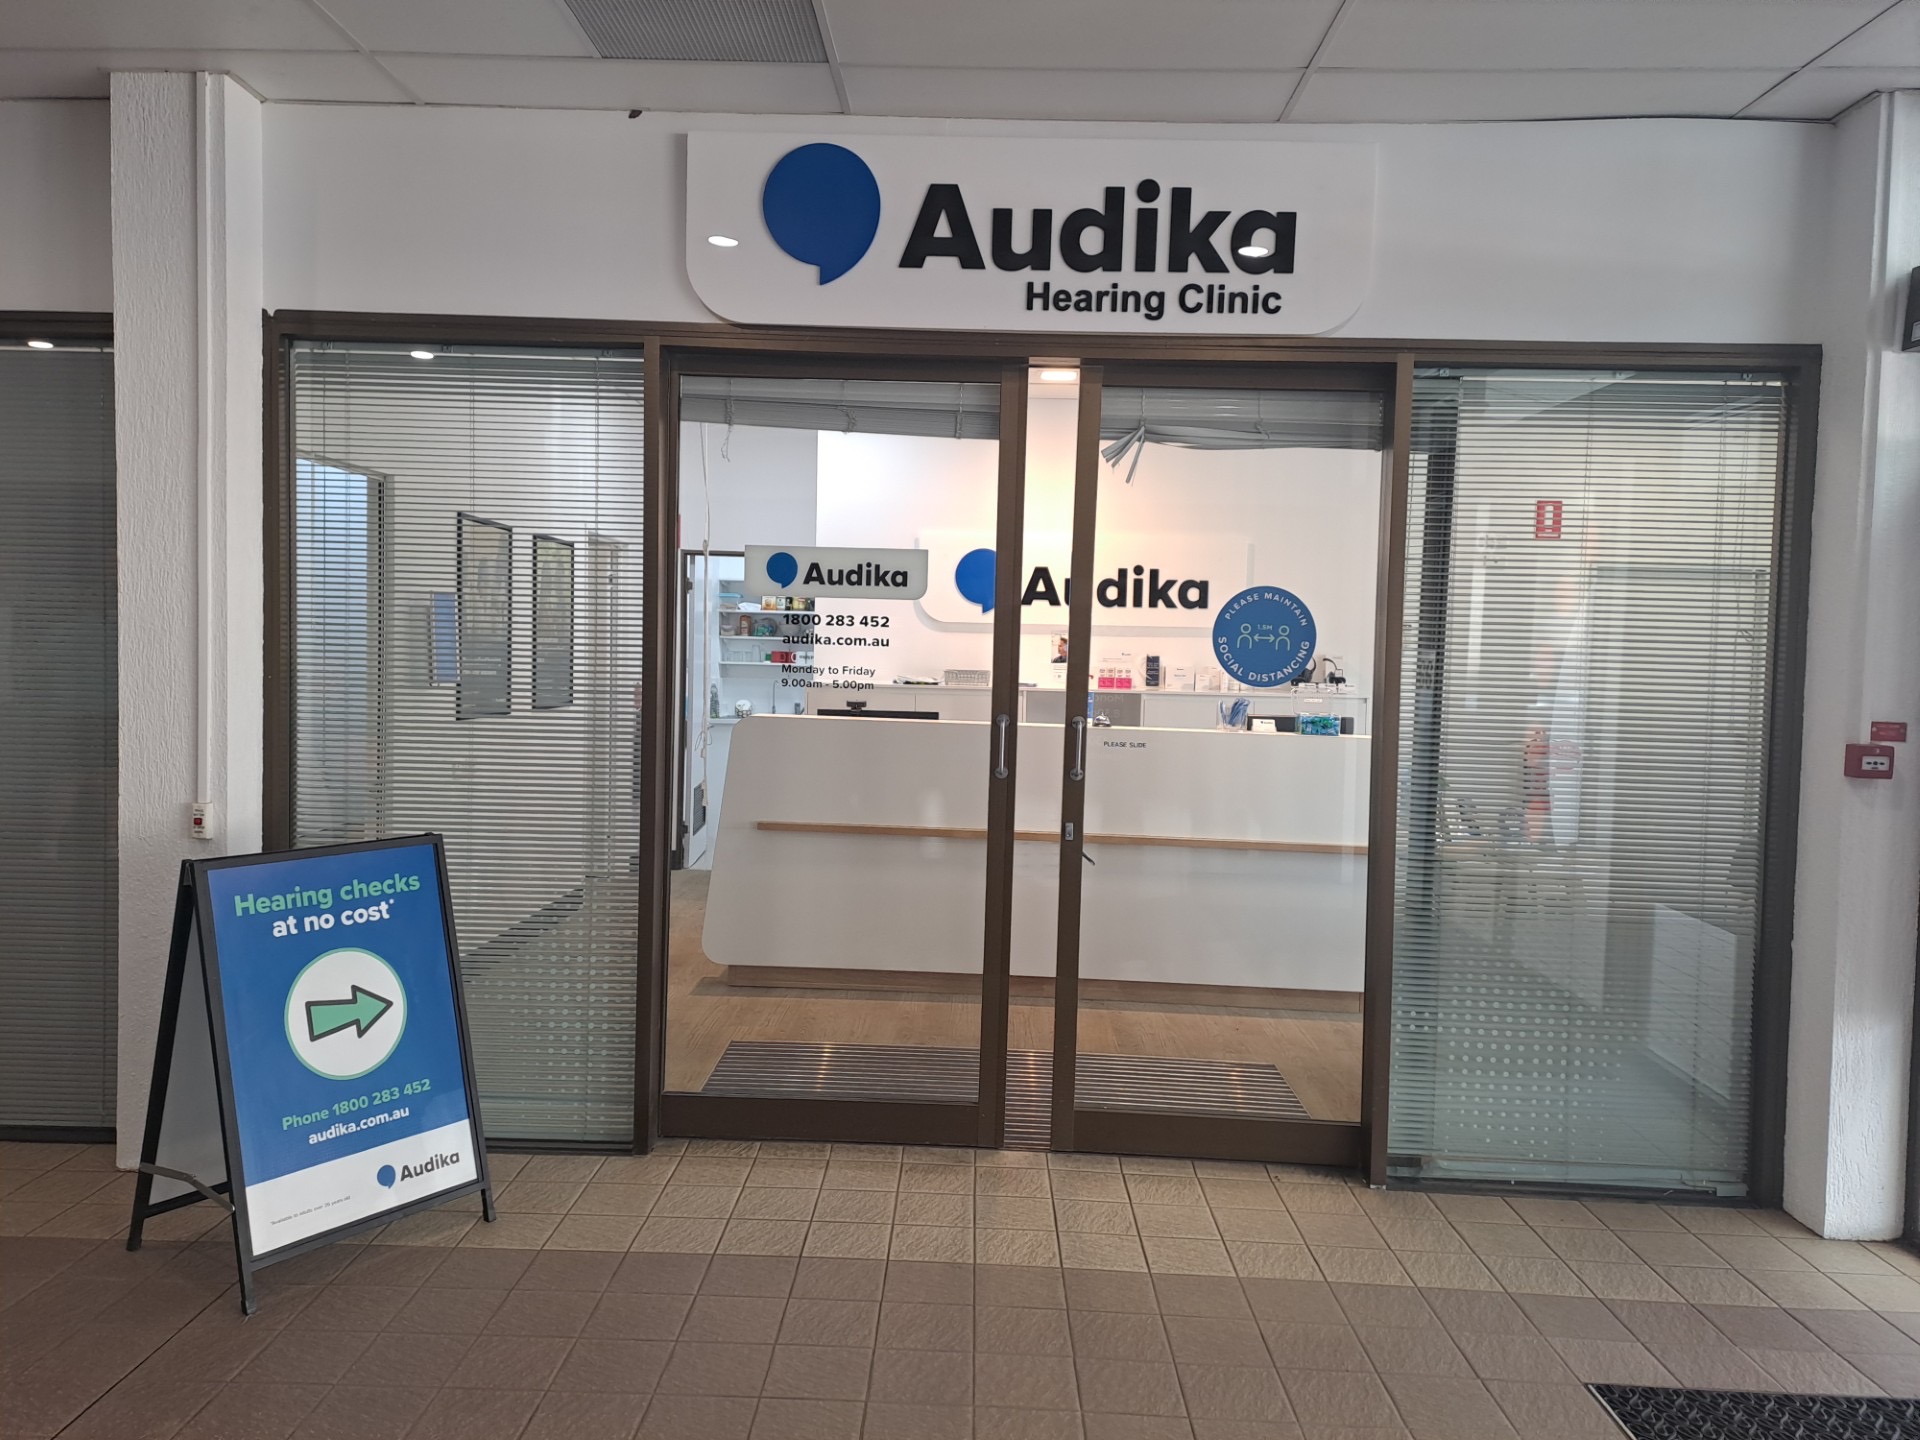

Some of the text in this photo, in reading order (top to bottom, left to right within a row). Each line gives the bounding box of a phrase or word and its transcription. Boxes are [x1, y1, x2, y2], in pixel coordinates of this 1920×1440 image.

[899, 178, 1297, 275] Audika
[1026, 281, 1282, 321] Hearing Clinic
[803, 562, 908, 588] Audika
[1020, 564, 1209, 610] Adika
[782, 613, 890, 628] 1800 283 452
[1224, 592, 1308, 626] PLEASE MAINTAIN
[782, 631, 890, 648] audika.com.au
[781, 664, 876, 677] Monday to Friday
[1218, 636, 1310, 683] SOCIAL DISTANCING
[781, 678, 823, 689] 9.00am
[832, 680, 875, 691] 5.00pm
[1103, 740, 1127, 748] PLEASE
[234, 873, 421, 917] Hearing checks
[272, 915, 299, 938] at
[303, 913, 335, 933] no
[282, 1078, 432, 1131] Phone 1800 283 452
[308, 1106, 410, 1145] audika.com.au
[400, 1151, 461, 1182] Audika
